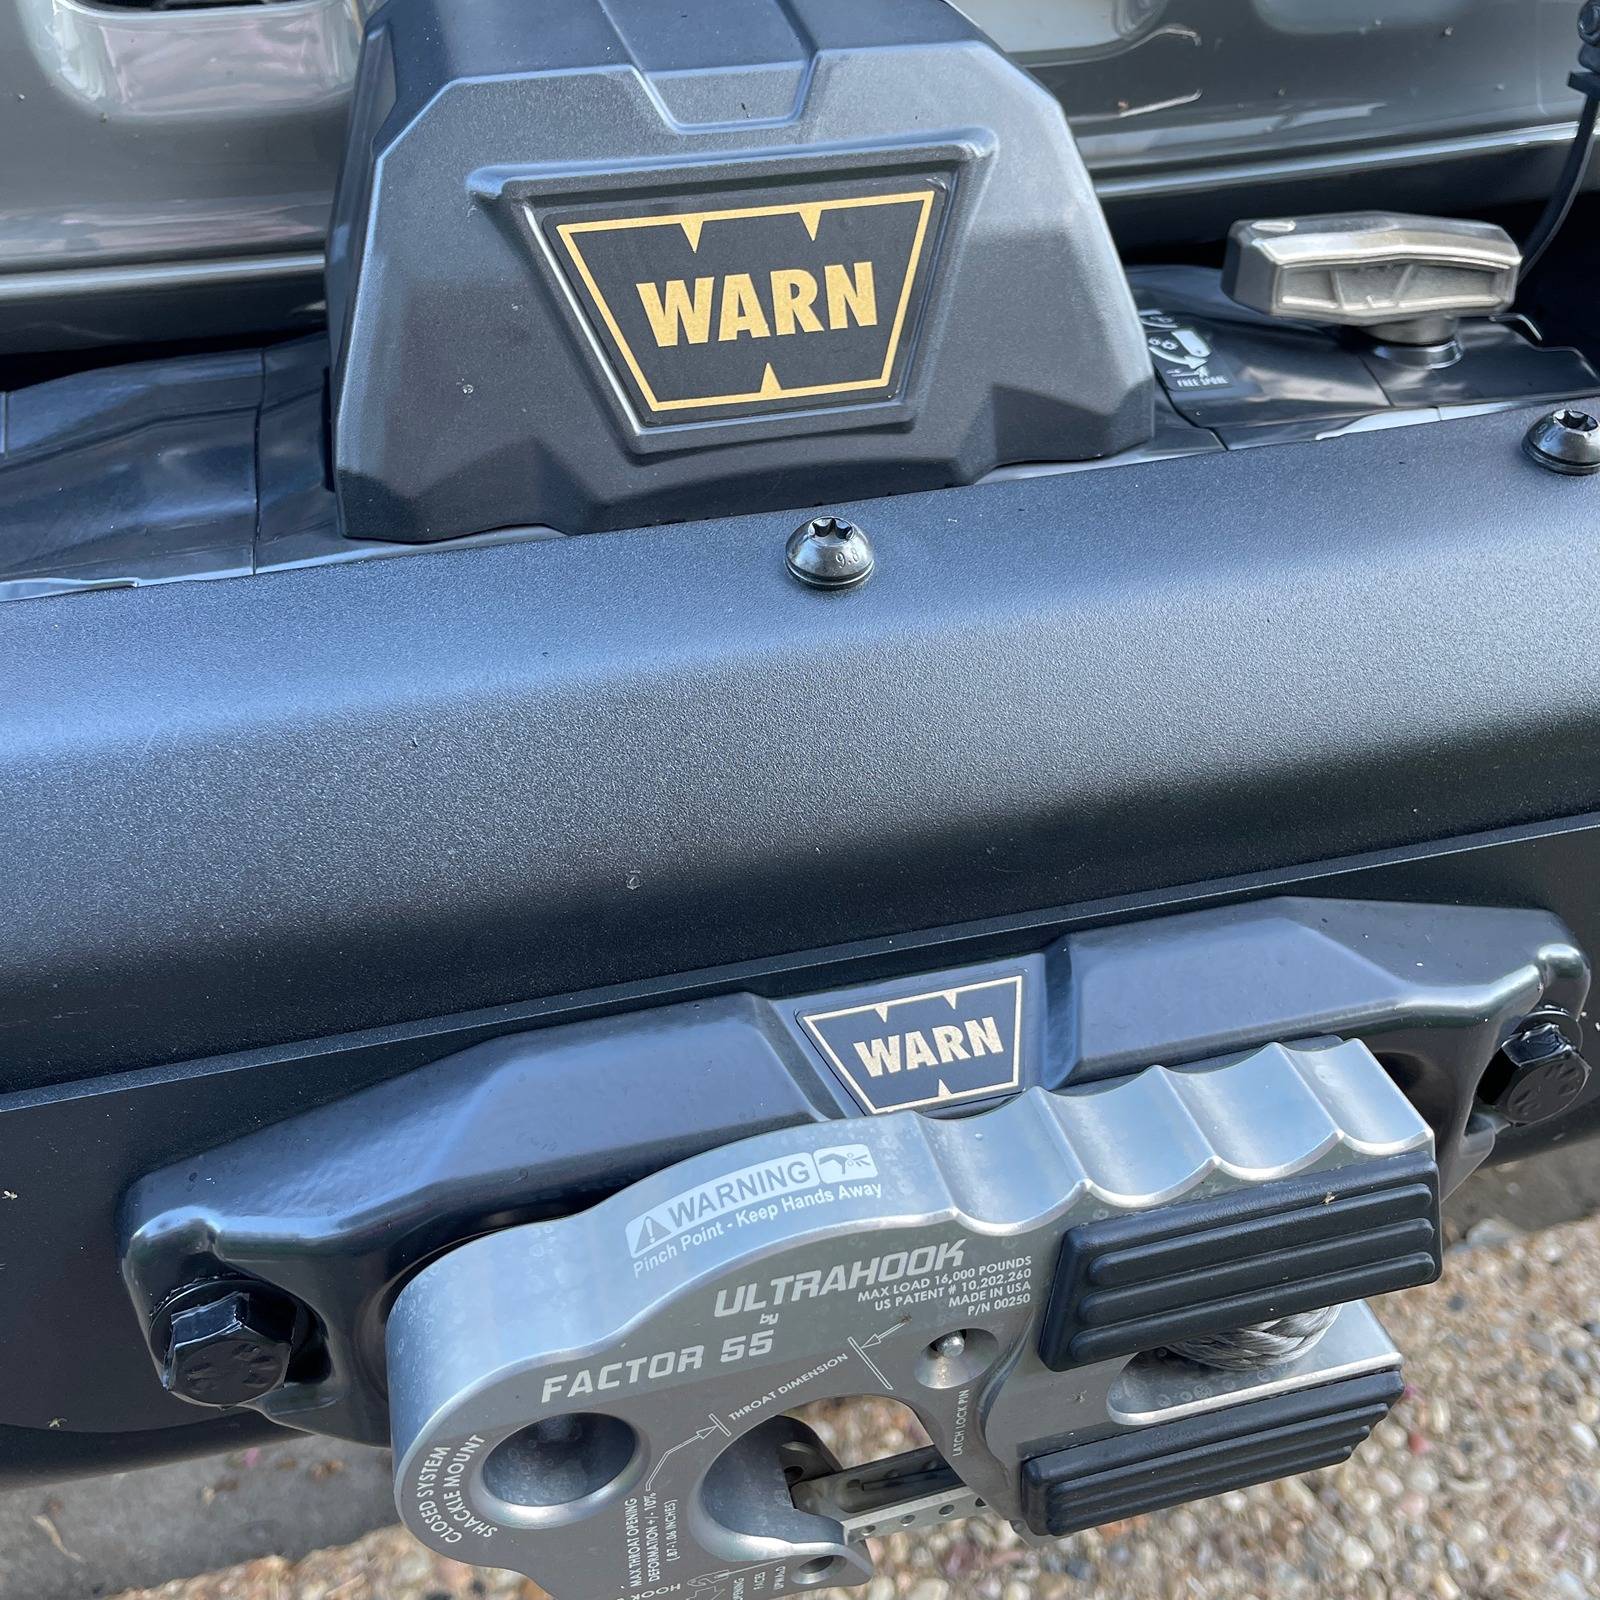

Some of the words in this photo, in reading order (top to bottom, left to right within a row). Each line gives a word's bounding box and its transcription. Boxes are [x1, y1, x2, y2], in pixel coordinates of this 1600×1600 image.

[635, 261, 877, 347] WARN
[853, 1016, 1004, 1077] WARN
[668, 1161, 811, 1228] WARNING
[633, 1242, 678, 1279] Pinch
[681, 1223, 724, 1252] Point
[736, 1203, 778, 1228] Keep
[783, 1188, 835, 1213] Hands
[838, 1181, 882, 1200] Away
[713, 1238, 967, 1318] ULTRAHOOK
[857, 1286, 890, 1302] MAX
[893, 1278, 930, 1295] LOAD
[935, 1268, 976, 1285] 16,000
[979, 1256, 1032, 1276] POUNDS
[875, 1299, 891, 1311] US
[895, 1287, 945, 1307] PATENT
[948, 1285, 957, 1295] #
[948, 1291, 986, 1307] MADE
[989, 1286, 1003, 1298] IN
[1006, 1281, 1032, 1295] USA
[760, 1313, 778, 1325] by
[967, 1303, 990, 1317] P/N
[994, 1293, 1031, 1310] 00250
[541, 1345, 704, 1404] FACTOR
[720, 1329, 774, 1363] 55
[728, 1391, 777, 1421] THROAT
[778, 1353, 849, 1394] DIMENSION
[956, 1405, 968, 1429] LOCK
[958, 1389, 970, 1405] PIN
[443, 1434, 485, 1487] MOUNT
[952, 1430, 965, 1457] LATCH
[416, 1446, 451, 1498] SYSTEM
[418, 1500, 462, 1543] CLOSED
[443, 1490, 498, 1538] SHACKLE
[624, 1498, 639, 1536] OPENING
[627, 1537, 641, 1568] THROAT
[645, 1525, 660, 1582] DEFORMATION
[630, 1567, 642, 1587] MAX
